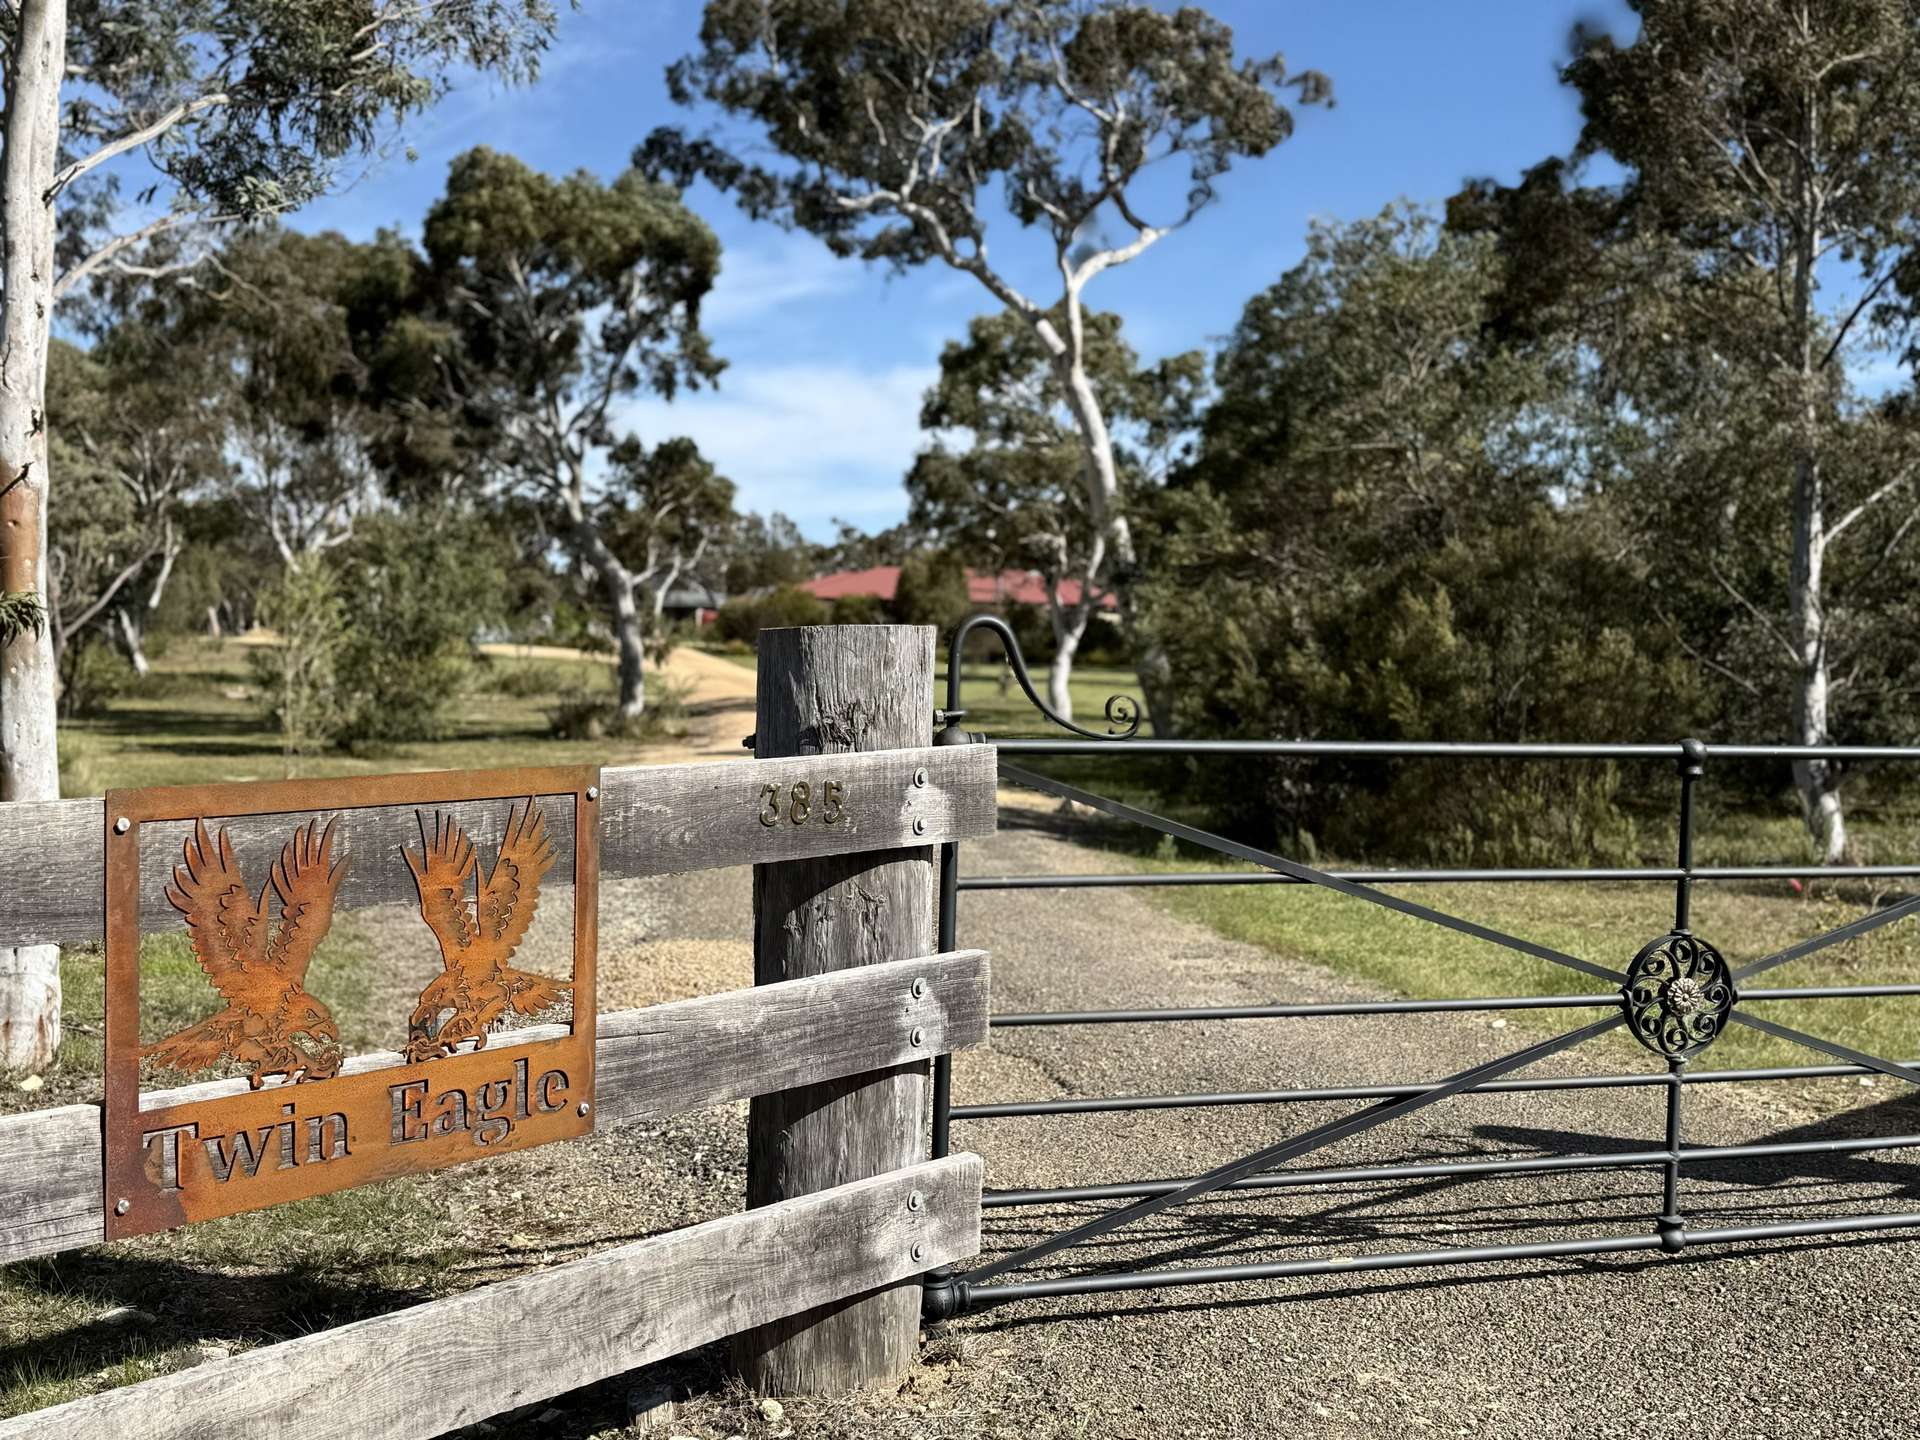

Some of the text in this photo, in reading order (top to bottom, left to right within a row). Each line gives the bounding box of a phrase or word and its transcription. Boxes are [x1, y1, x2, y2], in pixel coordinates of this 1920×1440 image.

[759, 780, 844, 827] 385
[142, 1057, 570, 1195] Twin Eagle
